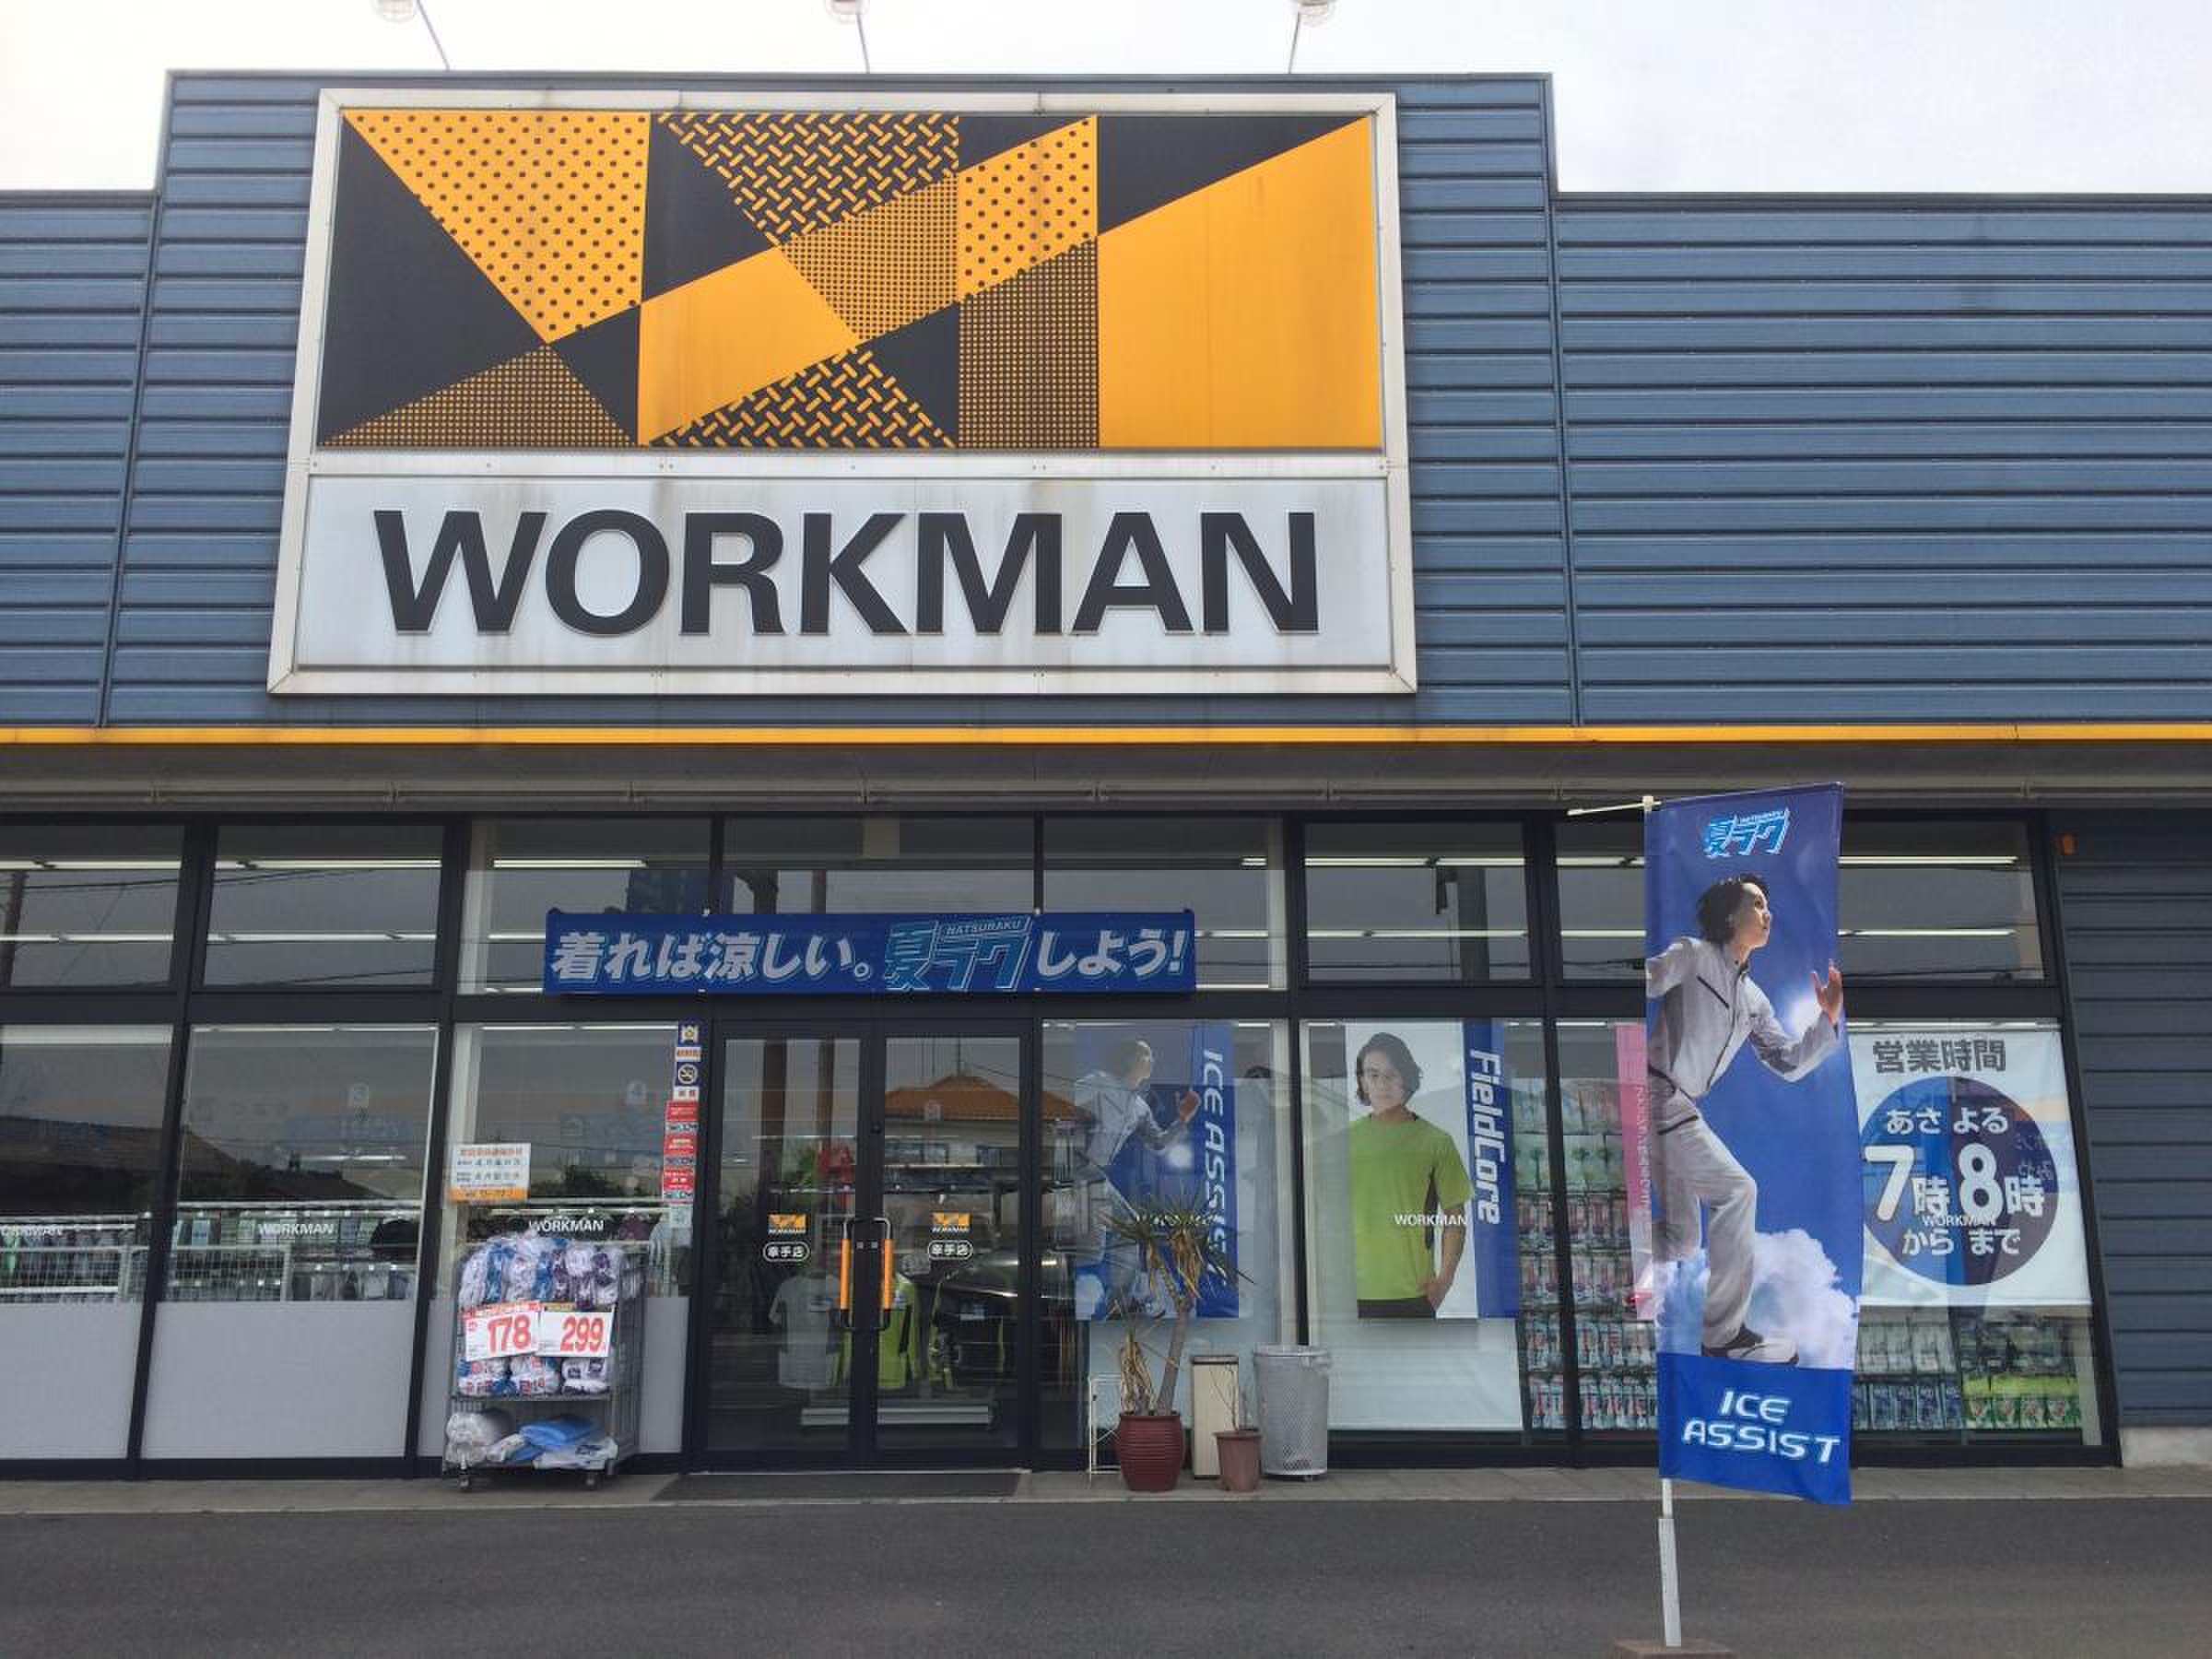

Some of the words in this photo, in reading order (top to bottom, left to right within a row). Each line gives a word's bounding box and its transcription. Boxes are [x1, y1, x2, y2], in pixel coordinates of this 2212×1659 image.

[373, 509, 1319, 636] WORKMAN
[1873, 1039, 2007, 1073] 営業時間
[1203, 1049, 1225, 1117] ICE
[1470, 1049, 1505, 1225] FieldCore
[1887, 1107, 1942, 1134] あさ
[1953, 1107, 2008, 1134] よる
[1394, 1215, 1467, 1226] WORKMAN
[1901, 1228, 1954, 1255] から
[1969, 1228, 2021, 1255] まで
[488, 1314, 532, 1353] 178
[560, 1315, 604, 1353] 299
[1720, 1390, 1792, 1422] ICE
[1682, 1418, 1841, 1464] ASSIST
